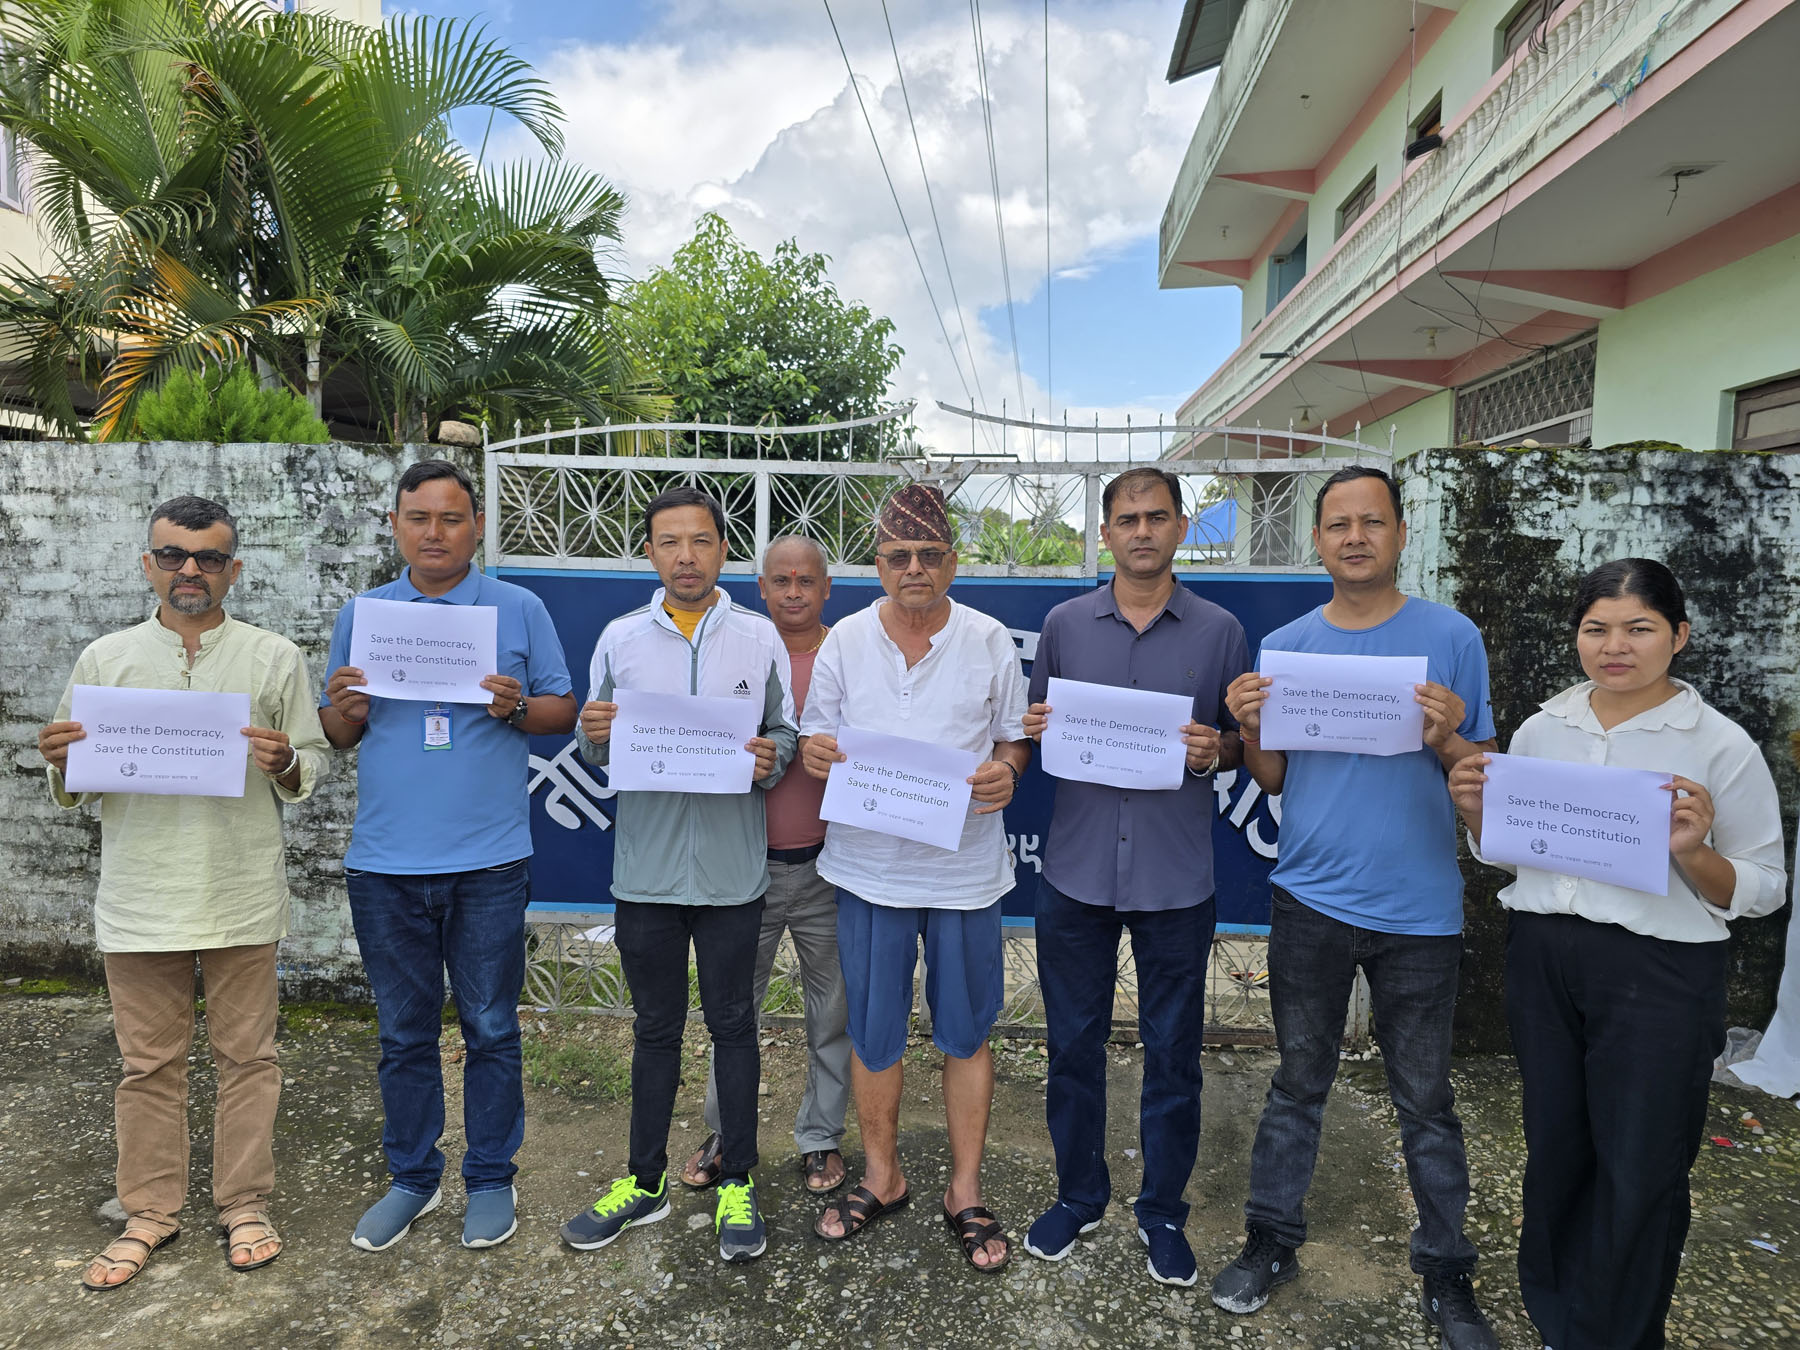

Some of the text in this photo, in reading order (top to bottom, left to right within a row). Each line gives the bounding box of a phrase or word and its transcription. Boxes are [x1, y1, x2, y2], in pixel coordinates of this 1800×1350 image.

[371, 634, 475, 650] Save the Democracy,
[369, 652, 476, 666] Save the Constitution
[1283, 688, 1399, 703] Save the Democracy,
[1282, 706, 1401, 720] Save the Constitution
[98, 724, 224, 739] Save the Democracy,
[633, 725, 736, 740] Save the Democracy,
[1065, 715, 1167, 737] Save the Democracy,
[95, 744, 224, 756] Save the Constitution
[630, 743, 736, 755] Save the Constitution
[1062, 732, 1166, 754] Save the Constitution
[853, 762, 951, 791] Save the Democracy,
[848, 777, 949, 808] Save the Constitution
[1508, 795, 1640, 824] Save the Democracy,
[1506, 815, 1640, 845] Save the Constitution
